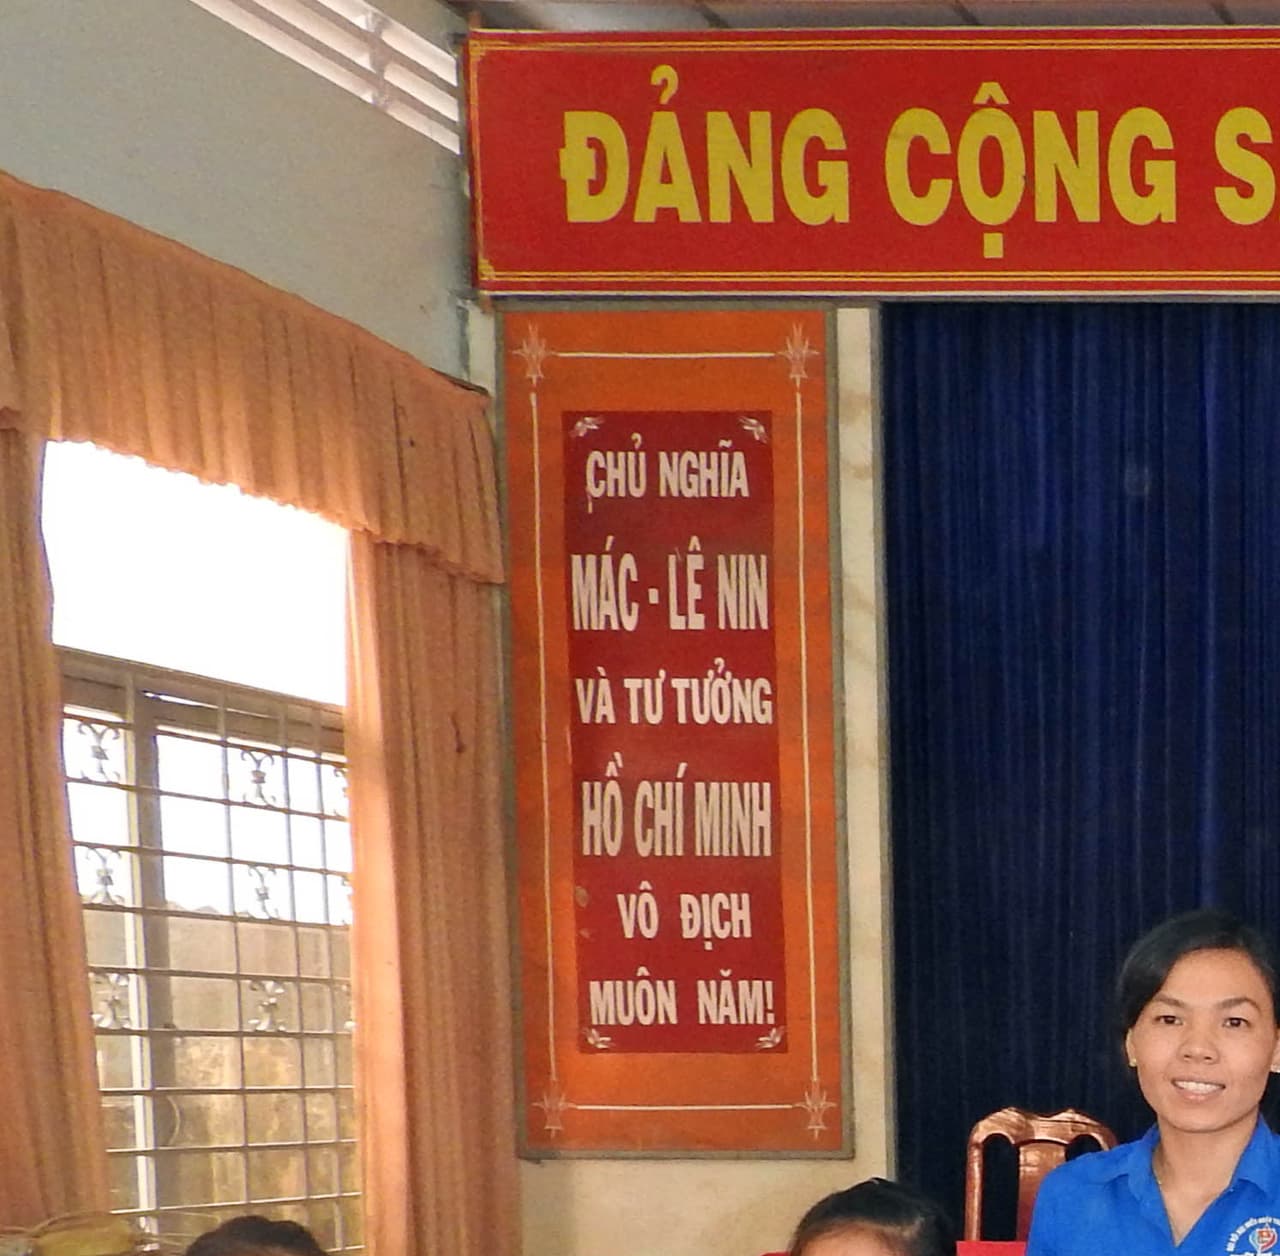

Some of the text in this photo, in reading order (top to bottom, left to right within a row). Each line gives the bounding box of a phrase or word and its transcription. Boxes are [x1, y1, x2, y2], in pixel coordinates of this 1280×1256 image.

[559, 65, 849, 225] ĐẢNG
[885, 82, 1176, 258] CỘNG
[586, 433, 749, 497] CHỦ NGHĨA
[572, 536, 638, 631] MÁC
[669, 536, 705, 629] LÊ
[718, 554, 768, 629] NIN
[576, 658, 772, 724] VÀ TƯ TƯỞNG
[583, 752, 771, 856] HỒ CHÍ MINH
[617, 881, 751, 950] VÔ ĐỊCH
[590, 967, 677, 1025] MUÔN
